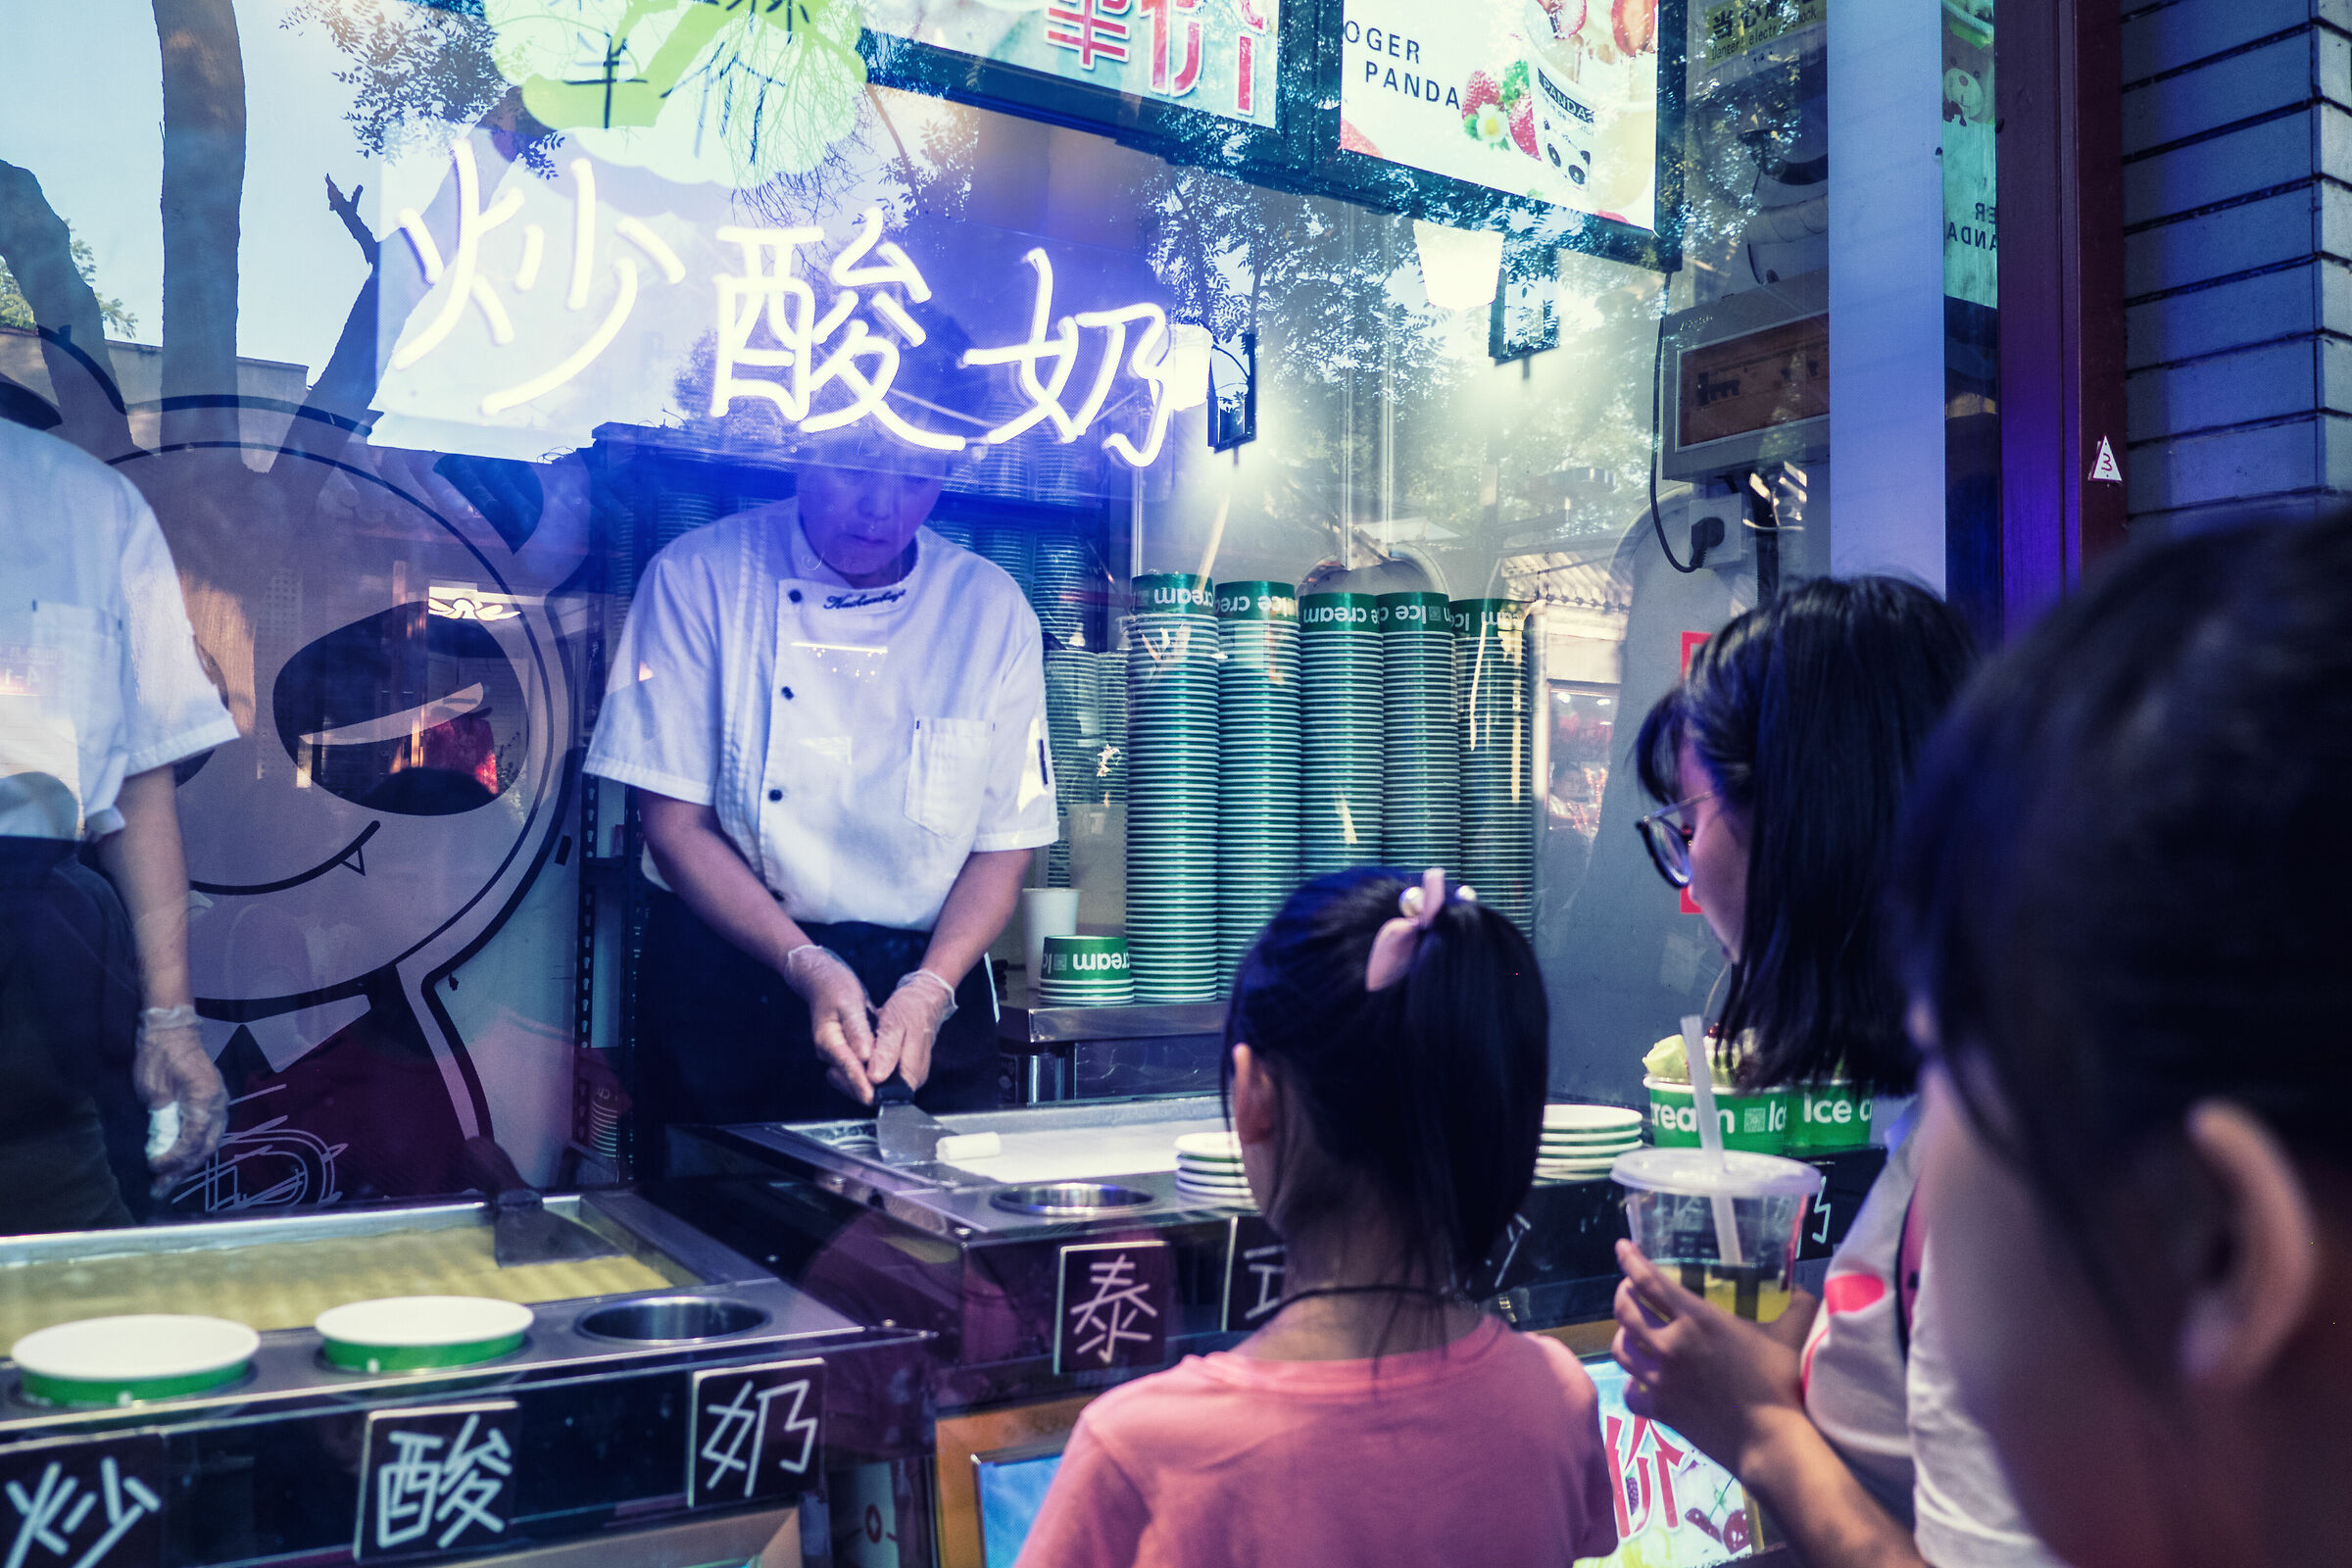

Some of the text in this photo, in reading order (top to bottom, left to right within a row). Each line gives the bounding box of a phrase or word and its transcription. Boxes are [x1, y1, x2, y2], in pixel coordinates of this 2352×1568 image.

[1345, 20, 1420, 65] OGER
[1365, 61, 1460, 111] PANDA
[1542, 76, 1589, 122] PANDA
[391, 137, 1171, 468] 炒酸奶
[2101, 452, 2113, 471] 3
[1303, 606, 1367, 623] cream
[1395, 605, 1427, 624] Ice
[1803, 1093, 1852, 1123] Ice
[1070, 1253, 1157, 1363] 泰
[4, 1380, 818, 1568] 炒 酸 奶
